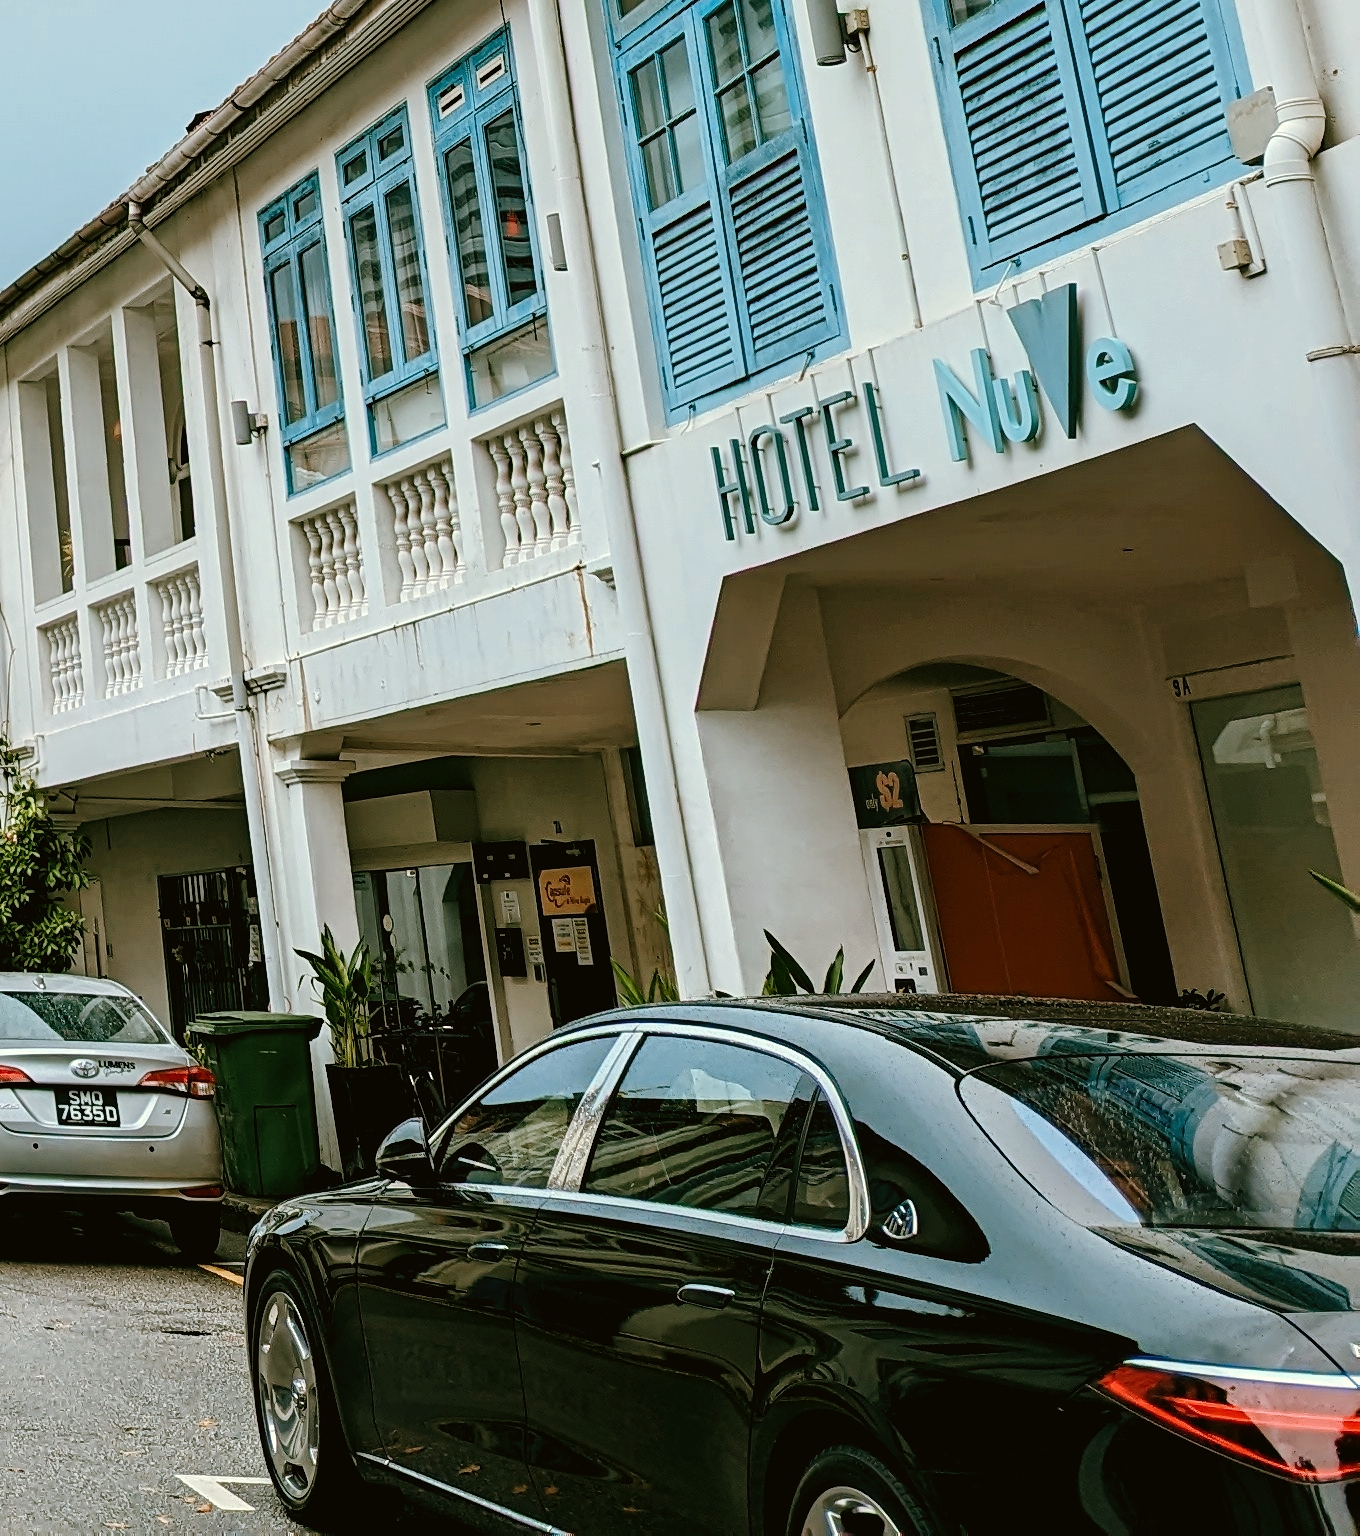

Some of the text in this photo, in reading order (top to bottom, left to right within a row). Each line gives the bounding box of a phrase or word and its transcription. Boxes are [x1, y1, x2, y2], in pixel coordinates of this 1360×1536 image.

[710, 382, 920, 541] HOTEL
[1173, 677, 1191, 697] 9A
[876, 771, 903, 812] $2
[68, 1090, 104, 1105] SMQ
[58, 1105, 118, 1122] 7635D
